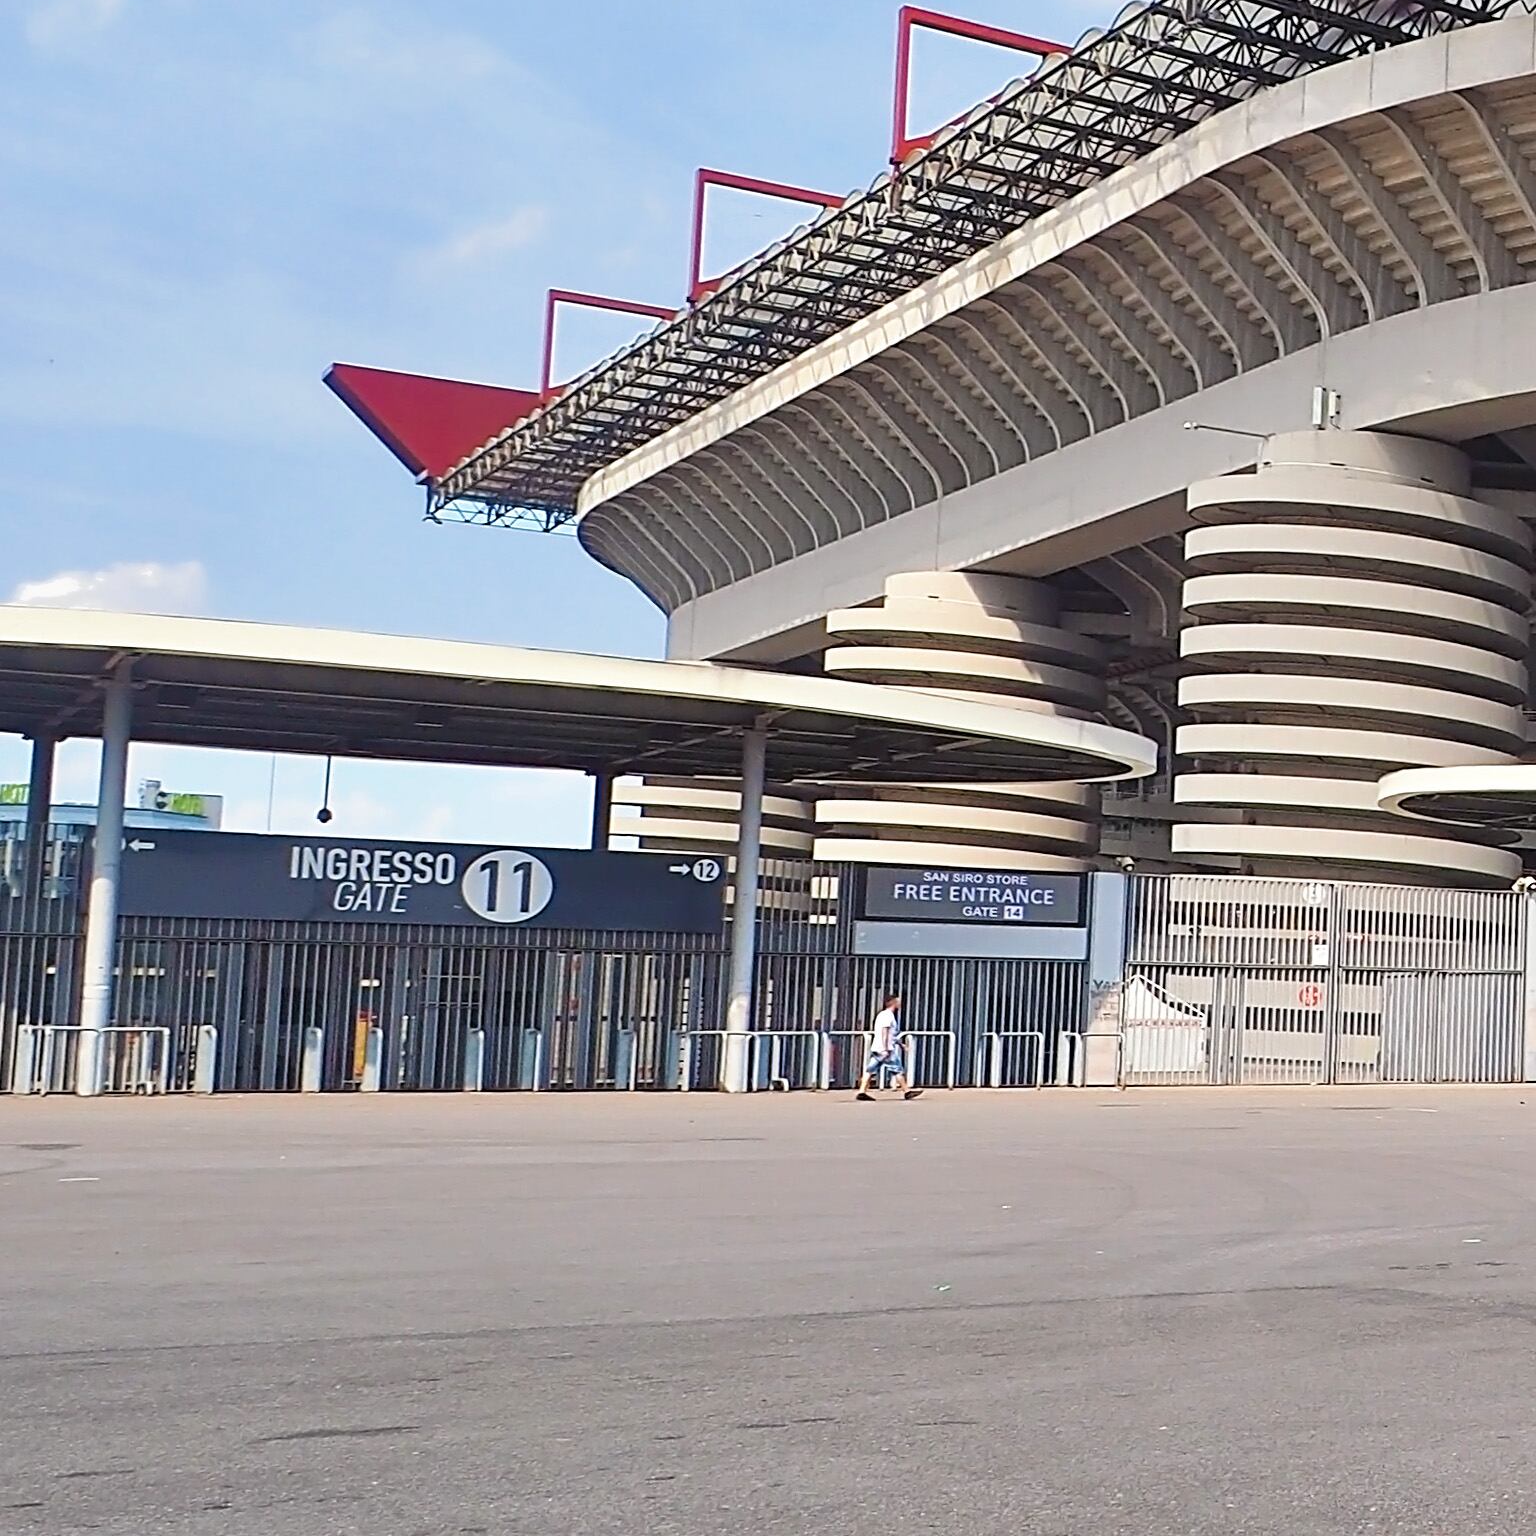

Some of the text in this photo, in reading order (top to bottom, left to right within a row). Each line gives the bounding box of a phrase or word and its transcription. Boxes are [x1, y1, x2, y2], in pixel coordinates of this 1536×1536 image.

[289, 846, 456, 885] INGRESSO
[698, 862, 715, 878] 12
[479, 860, 533, 913] 11
[923, 871, 1028, 886] SAN SIRO STORE
[333, 881, 412, 913] GATE
[893, 884, 1054, 905] FREE ENTRANCE
[962, 906, 1022, 919] GATE 14
